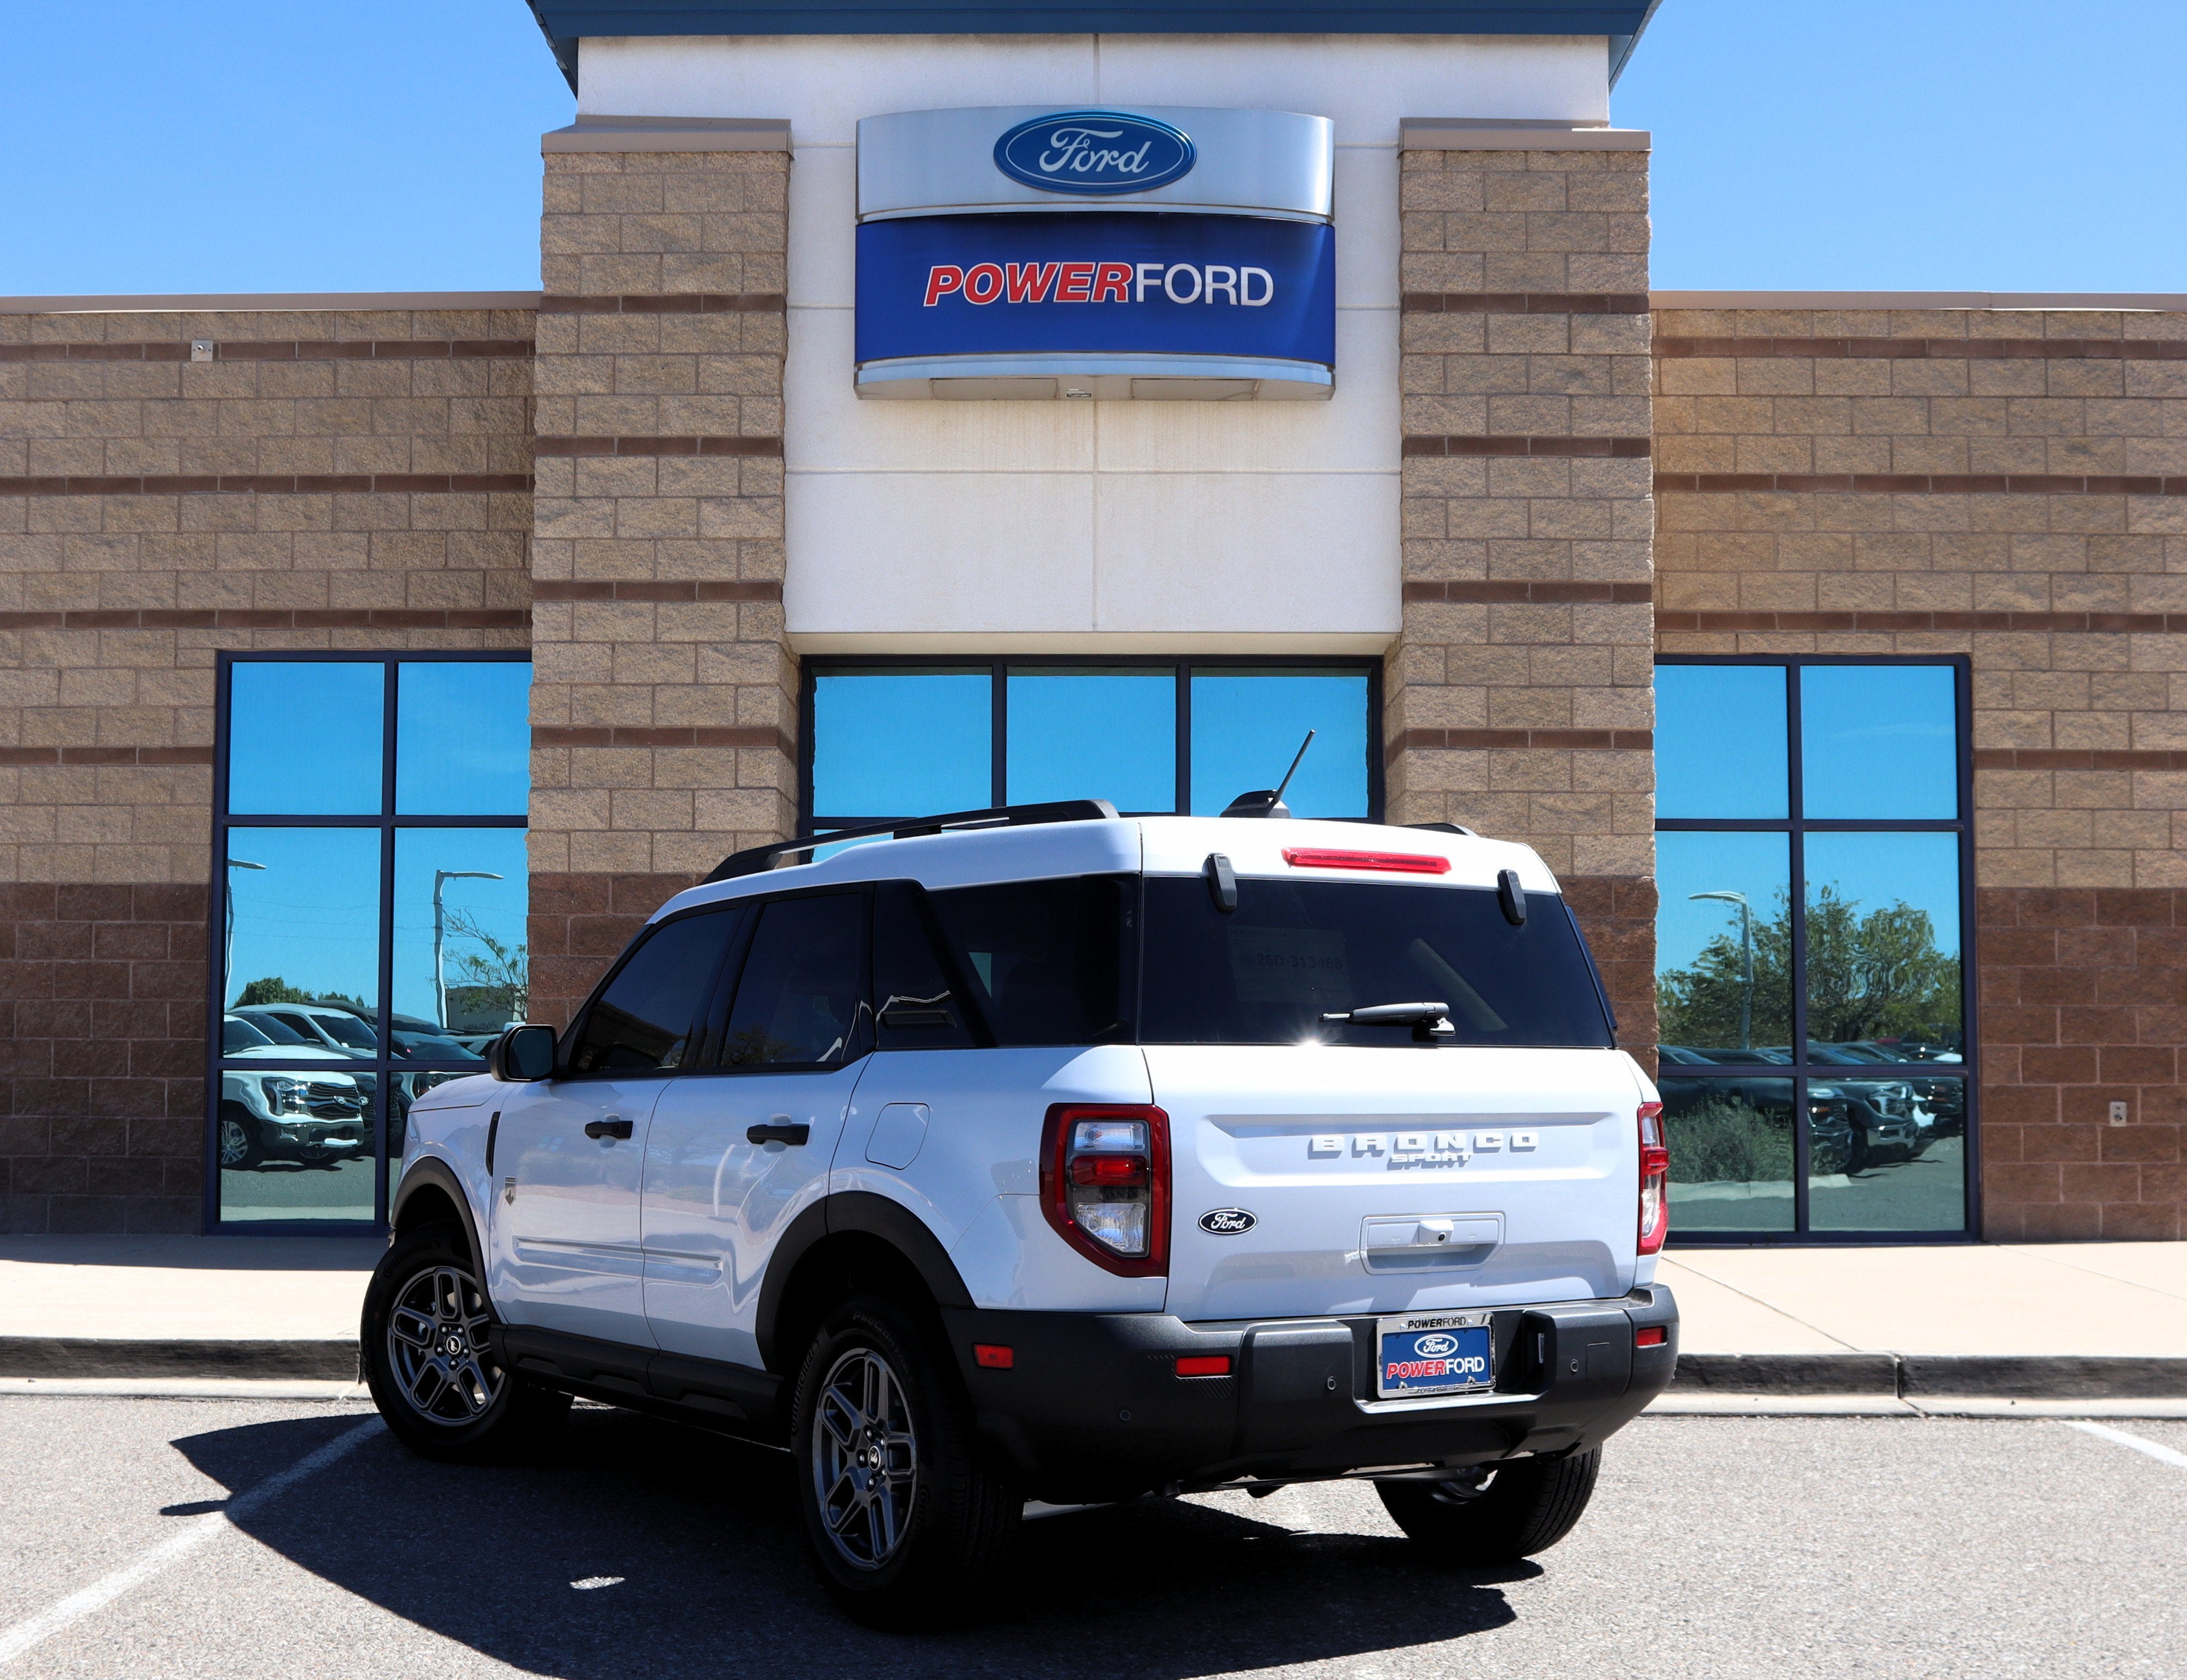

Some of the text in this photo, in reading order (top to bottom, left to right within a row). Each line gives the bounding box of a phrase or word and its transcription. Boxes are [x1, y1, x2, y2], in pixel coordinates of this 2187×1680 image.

[1038, 127, 1151, 173] Ford
[923, 261, 1275, 307] POWERFORD
[1310, 1132, 1539, 1153] BRONCO
[1390, 1151, 1473, 1163] SPORT
[1210, 1212, 1247, 1229] Ford
[1407, 1316, 1466, 1329] POWERFORD
[1423, 1338, 1449, 1353] Ford
[1386, 1356, 1485, 1379] POWERFORD
